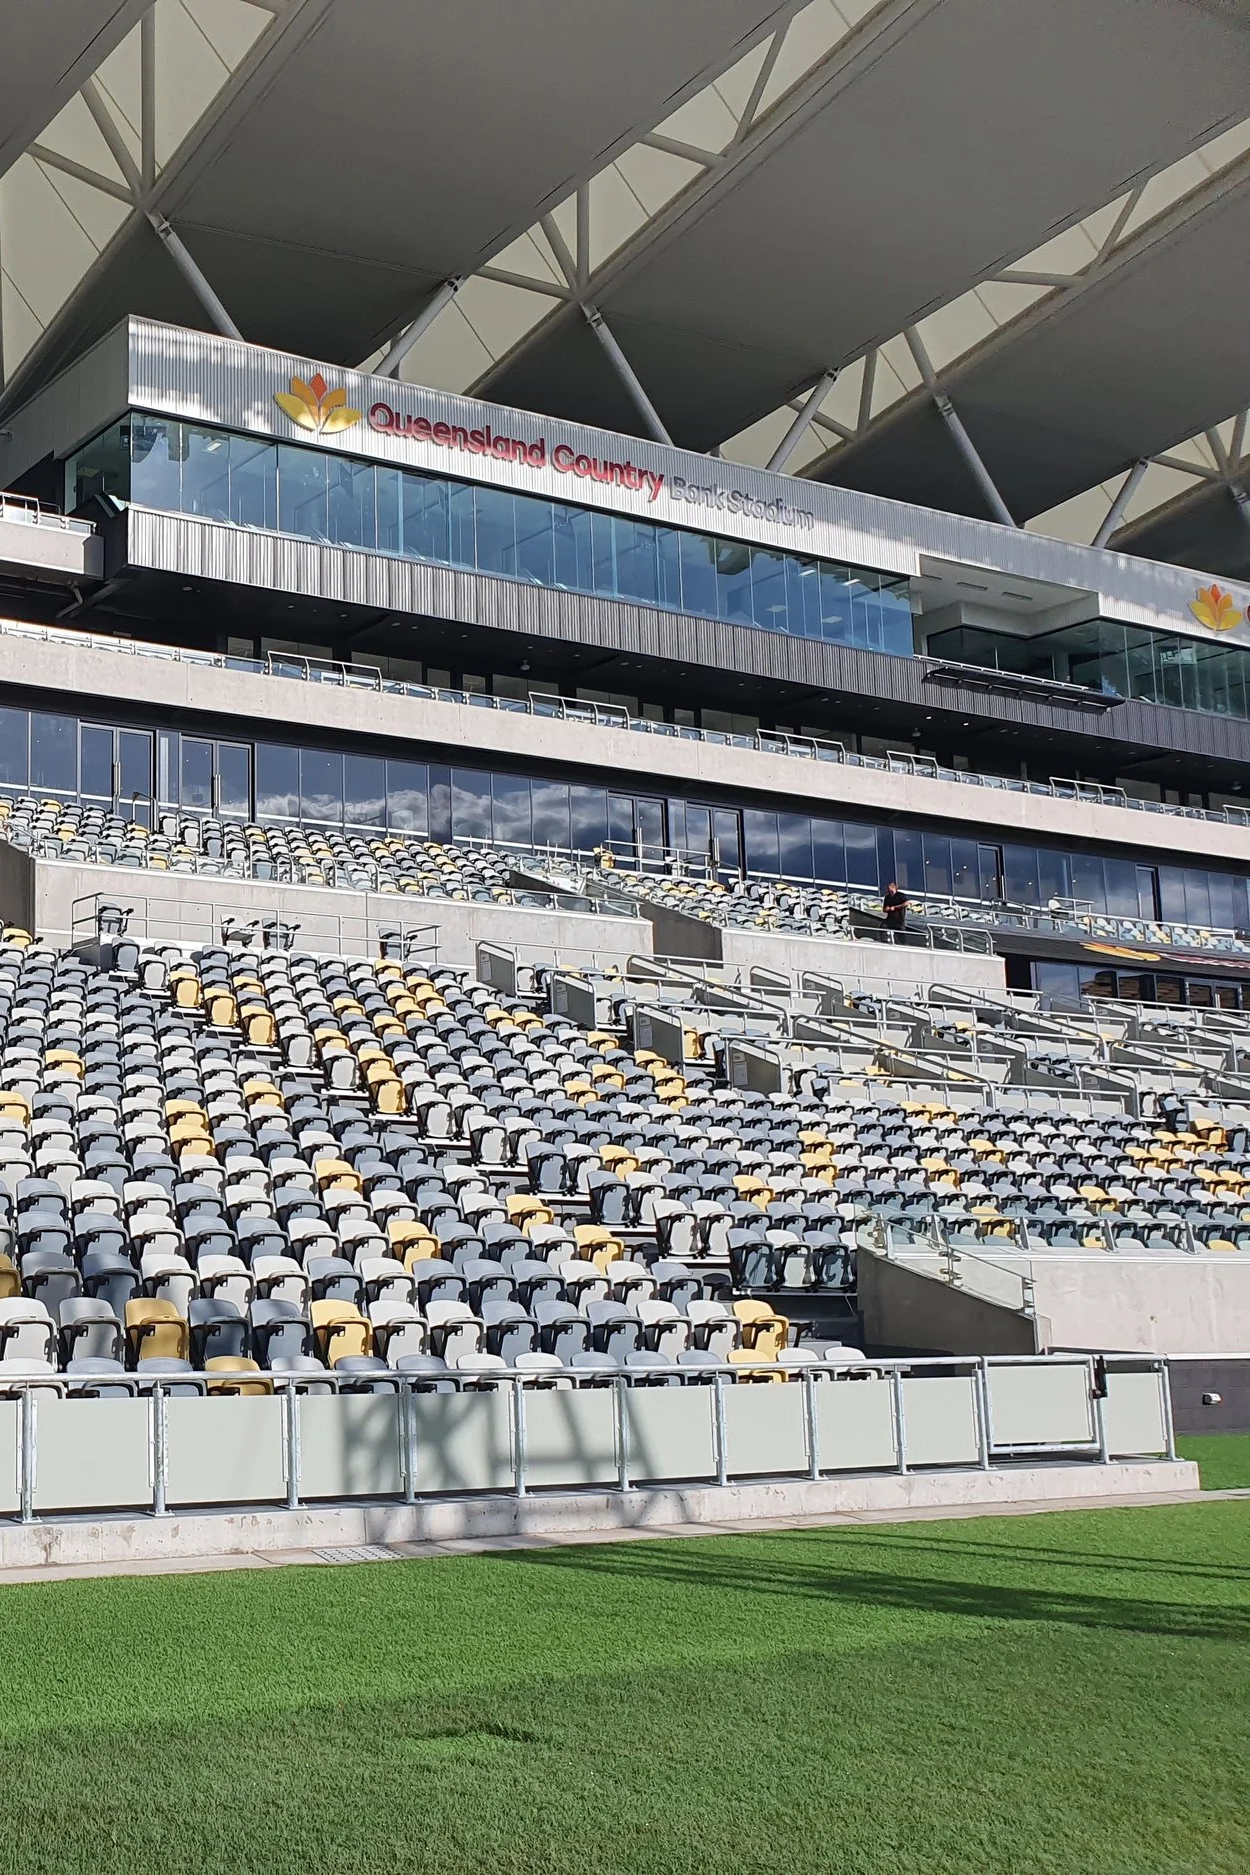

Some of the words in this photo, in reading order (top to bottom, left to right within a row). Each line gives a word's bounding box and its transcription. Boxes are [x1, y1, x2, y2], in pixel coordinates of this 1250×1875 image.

[368, 402, 546, 468] Queensland
[552, 443, 665, 502] Country
[670, 475, 725, 511] Bank
[726, 489, 815, 530] Stadium
